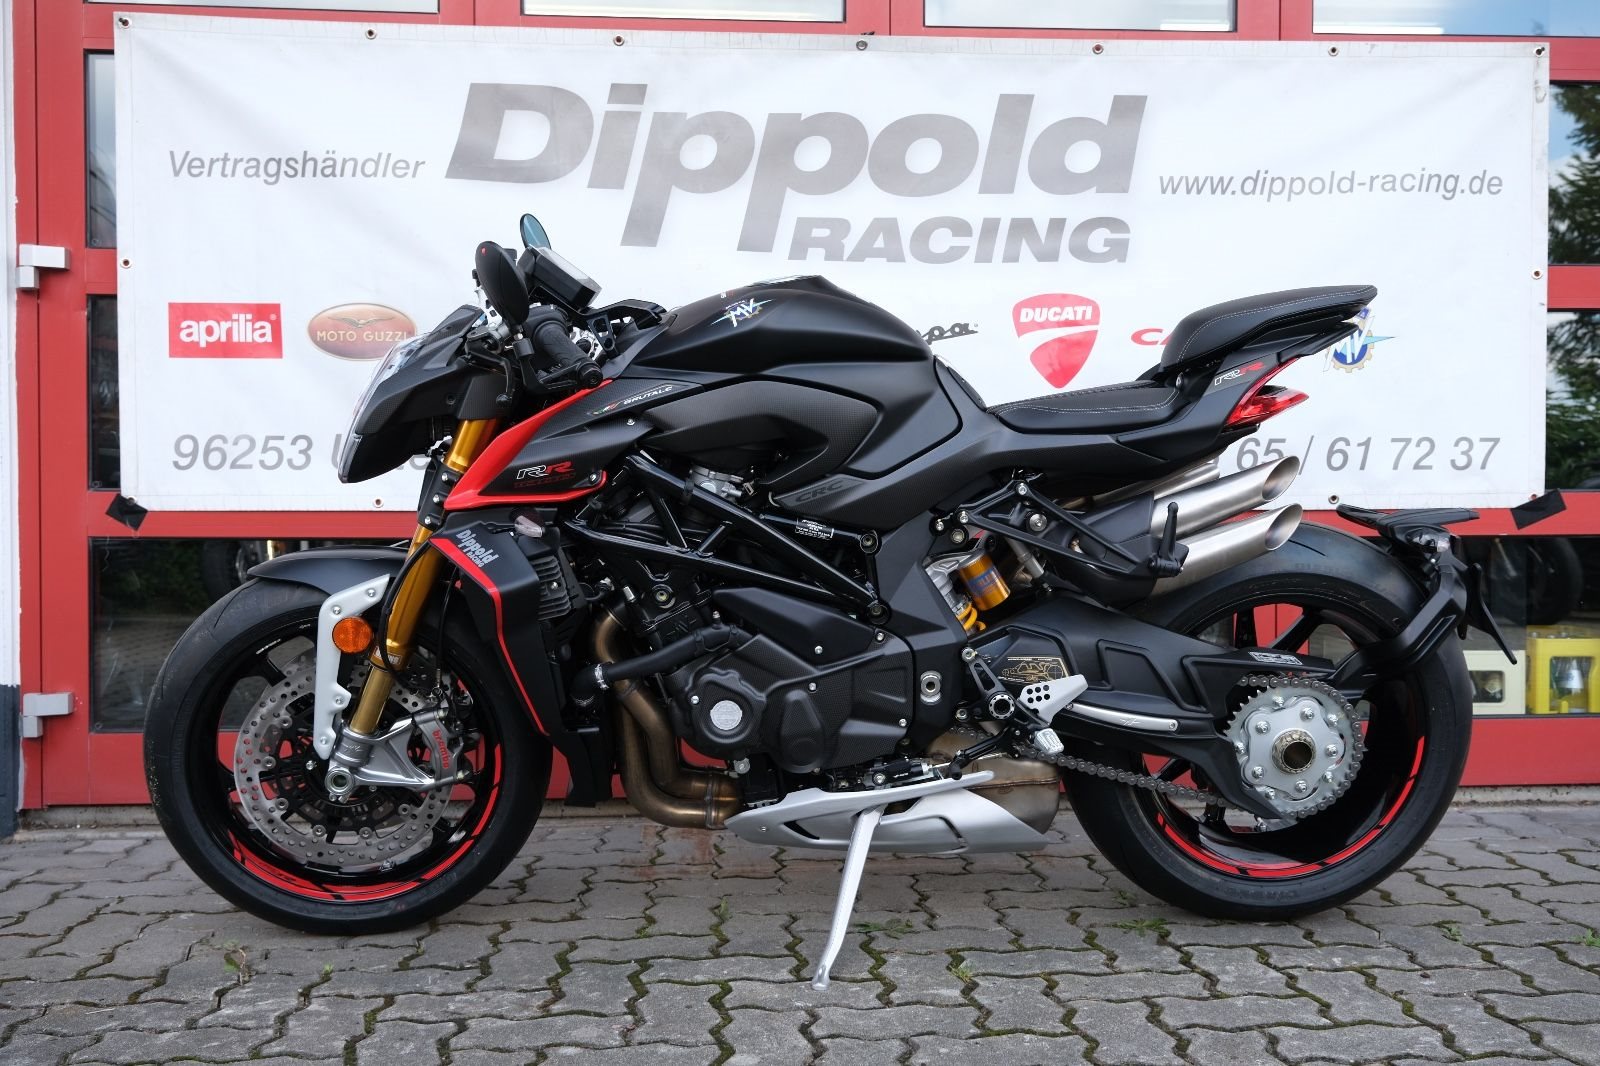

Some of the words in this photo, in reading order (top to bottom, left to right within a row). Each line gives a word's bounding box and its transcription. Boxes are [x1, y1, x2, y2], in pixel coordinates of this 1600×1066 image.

[169, 150, 426, 186] Vertragshändler
[445, 83, 1148, 252] Dippold
[1158, 169, 1503, 202] www.dippold-racing.de
[788, 216, 1131, 264] RACING
[179, 313, 274, 348] aprilia
[1020, 305, 1093, 323] DUCATI
[316, 330, 356, 342] MOTO
[363, 331, 407, 344] GUZZI
[623, 385, 673, 405] BRUTALE
[172, 434, 314, 471] 96253
[1236, 437, 1287, 470] 65
[1326, 436, 1372, 471] 61
[1391, 436, 1436, 471] 72
[1450, 436, 1501, 471] 37
[796, 479, 843, 502] CRC
[455, 529, 499, 564] Dippold
[432, 730, 449, 769] brembo
